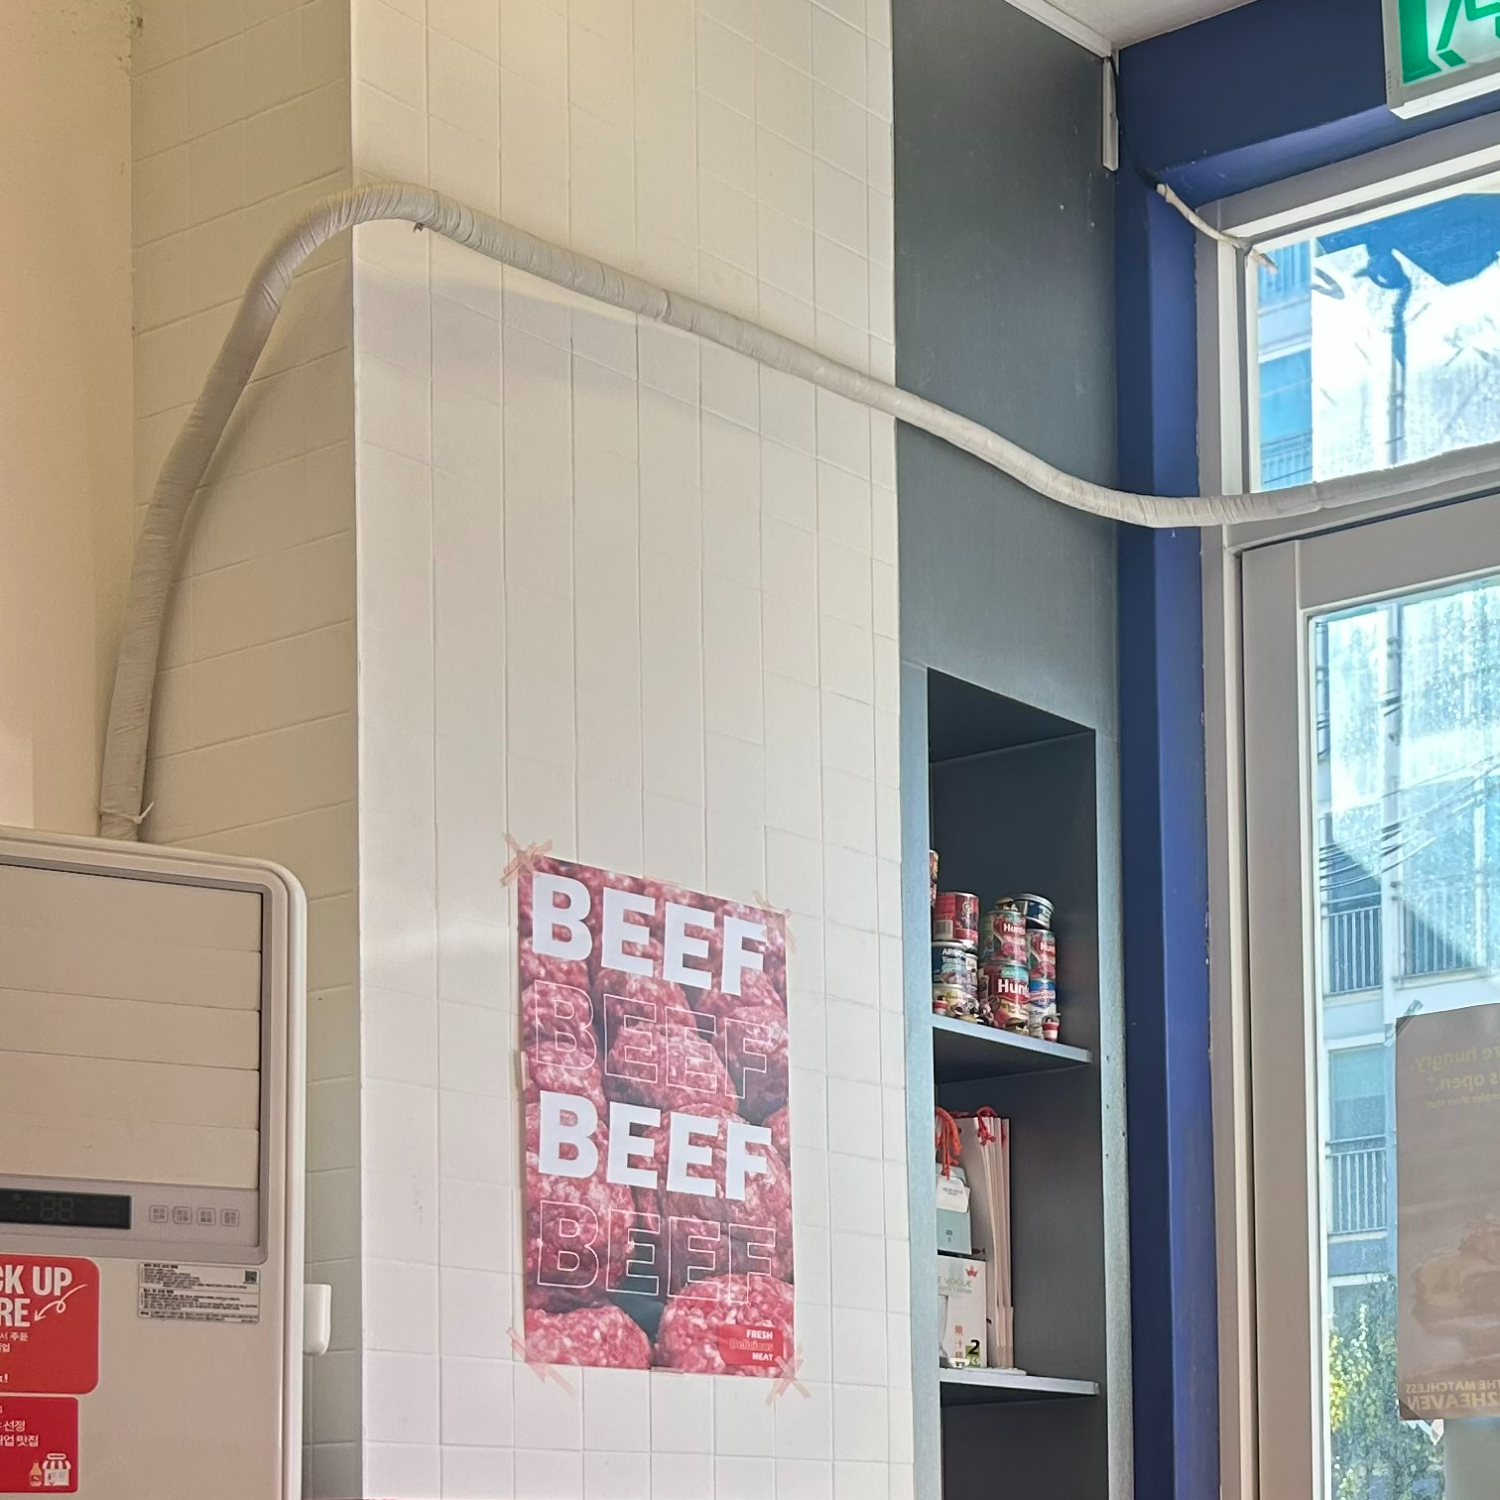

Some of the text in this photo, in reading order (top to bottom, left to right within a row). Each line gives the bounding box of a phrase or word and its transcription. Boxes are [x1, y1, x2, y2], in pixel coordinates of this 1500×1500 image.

[531, 872, 767, 996] BEEF
[533, 980, 772, 1099] BEEF
[538, 1090, 772, 1201] BEEF
[32, 1266, 73, 1296] UP
[537, 1200, 776, 1304] BEEF
[746, 1329, 774, 1340] FRESH
[752, 1352, 774, 1361] MEAT
